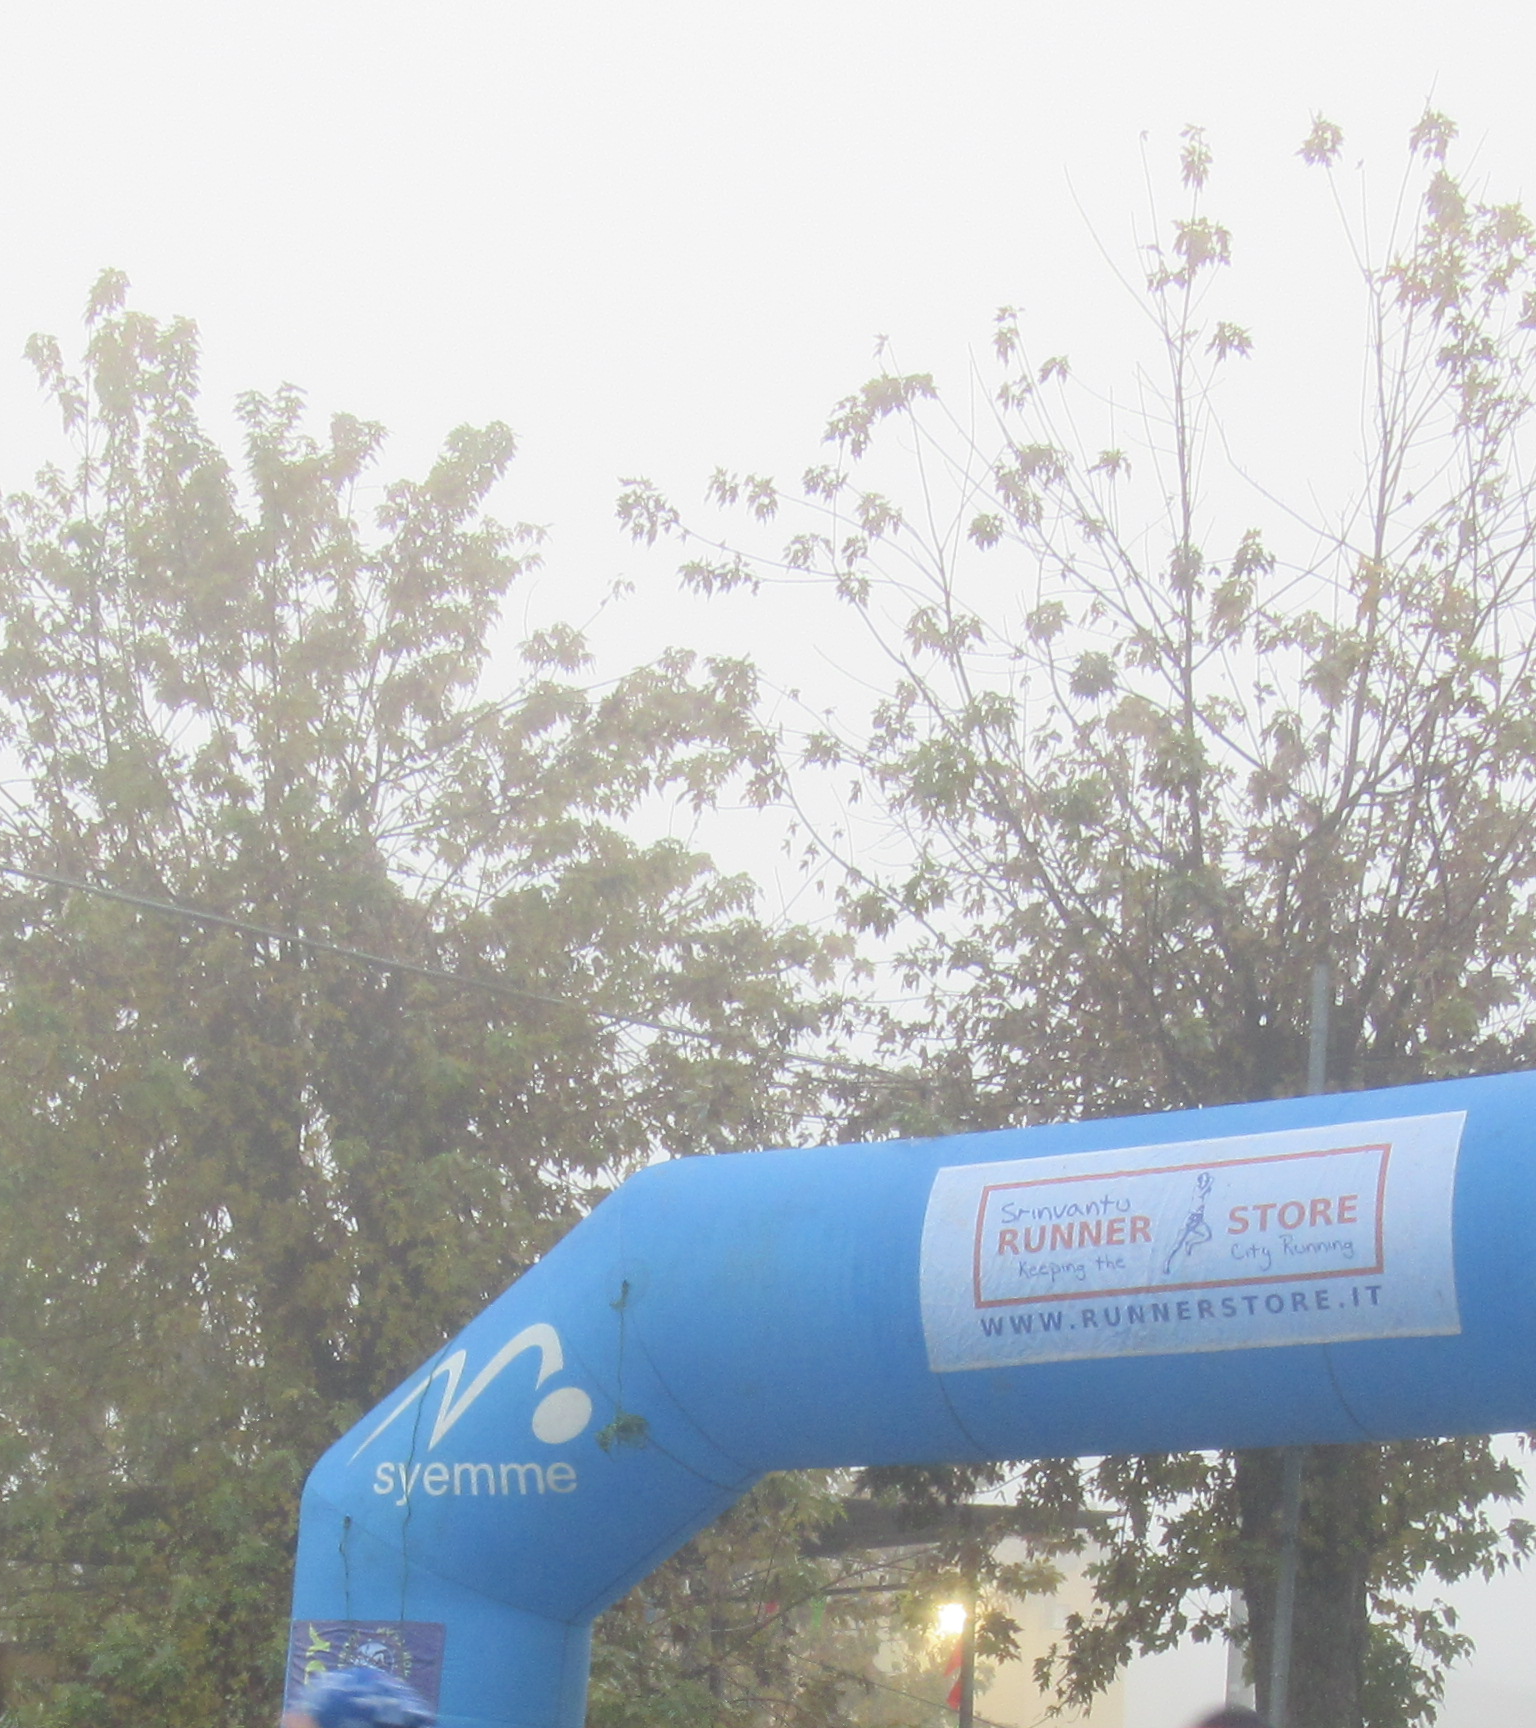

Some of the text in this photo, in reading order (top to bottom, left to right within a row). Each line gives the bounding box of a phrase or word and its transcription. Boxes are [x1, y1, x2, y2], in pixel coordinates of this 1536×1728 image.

[997, 1194, 1359, 1256] RUNNER STORE
[1018, 1233, 1355, 1283] Keeping the City Running
[980, 1285, 1383, 1338] WWW.RUNNERSTORE.IT
[372, 1460, 580, 1507] syemme
